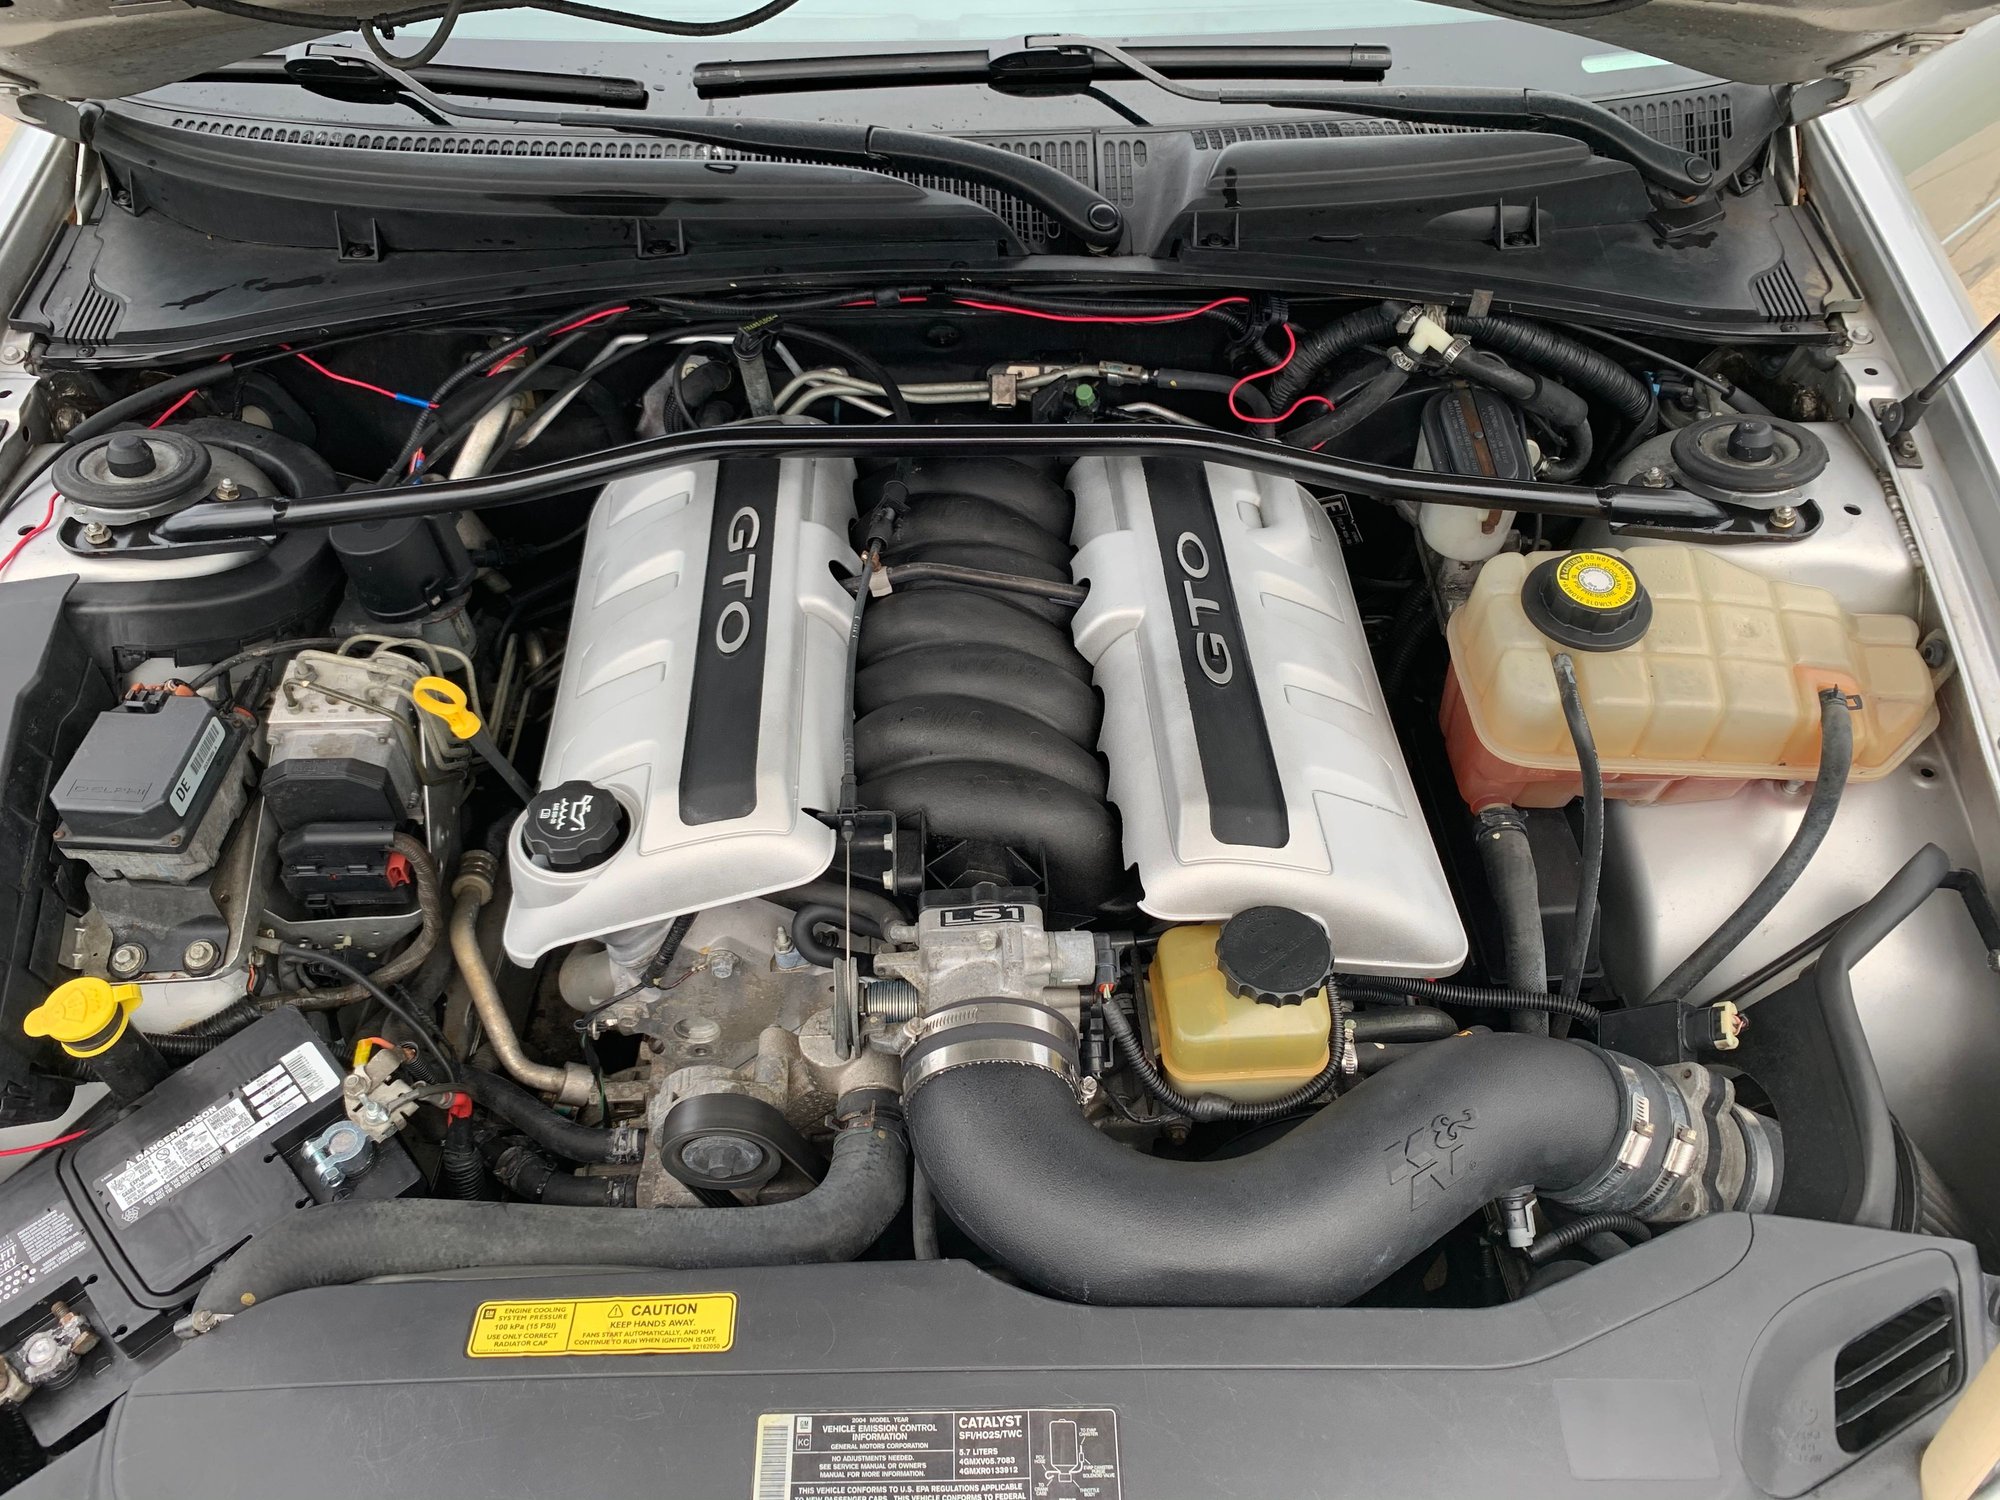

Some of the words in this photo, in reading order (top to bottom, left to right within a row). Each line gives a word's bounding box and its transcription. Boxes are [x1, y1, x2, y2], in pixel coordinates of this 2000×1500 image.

[1563, 557, 1582, 573] CAUTION
[1597, 555, 1610, 563] NOT
[1610, 561, 1631, 580] REMOVE
[728, 506, 760, 653] GTO
[1562, 582, 1583, 602] REMOVE
[1585, 599, 1613, 607] SLOWLY
[1176, 531, 1233, 685] GTO
[75, 785, 146, 796] DELPHI
[175, 777, 192, 802] DE
[944, 907, 1020, 923] LS1
[135, 1105, 218, 1162] DANGER/POISON
[1383, 1107, 1477, 1212] K&N
[631, 1303, 698, 1316] CAUTION
[540, 1322, 557, 1330] PSI)
[822, 1425, 856, 1433] VEHICLE
[858, 1424, 898, 1432] EMISSION
[958, 1415, 1022, 1428] CATALYST
[798, 1438, 810, 1447] KC
[959, 1429, 1023, 1440] SFI/HO2S/TWC
[816, 1486, 846, 1494] VEHICLE
[900, 1485, 915, 1493] U.S.
[916, 1485, 929, 1493] EPA
[931, 1484, 979, 1492] REGULATIONS
[981, 1483, 1023, 1491] APPLICABLE
